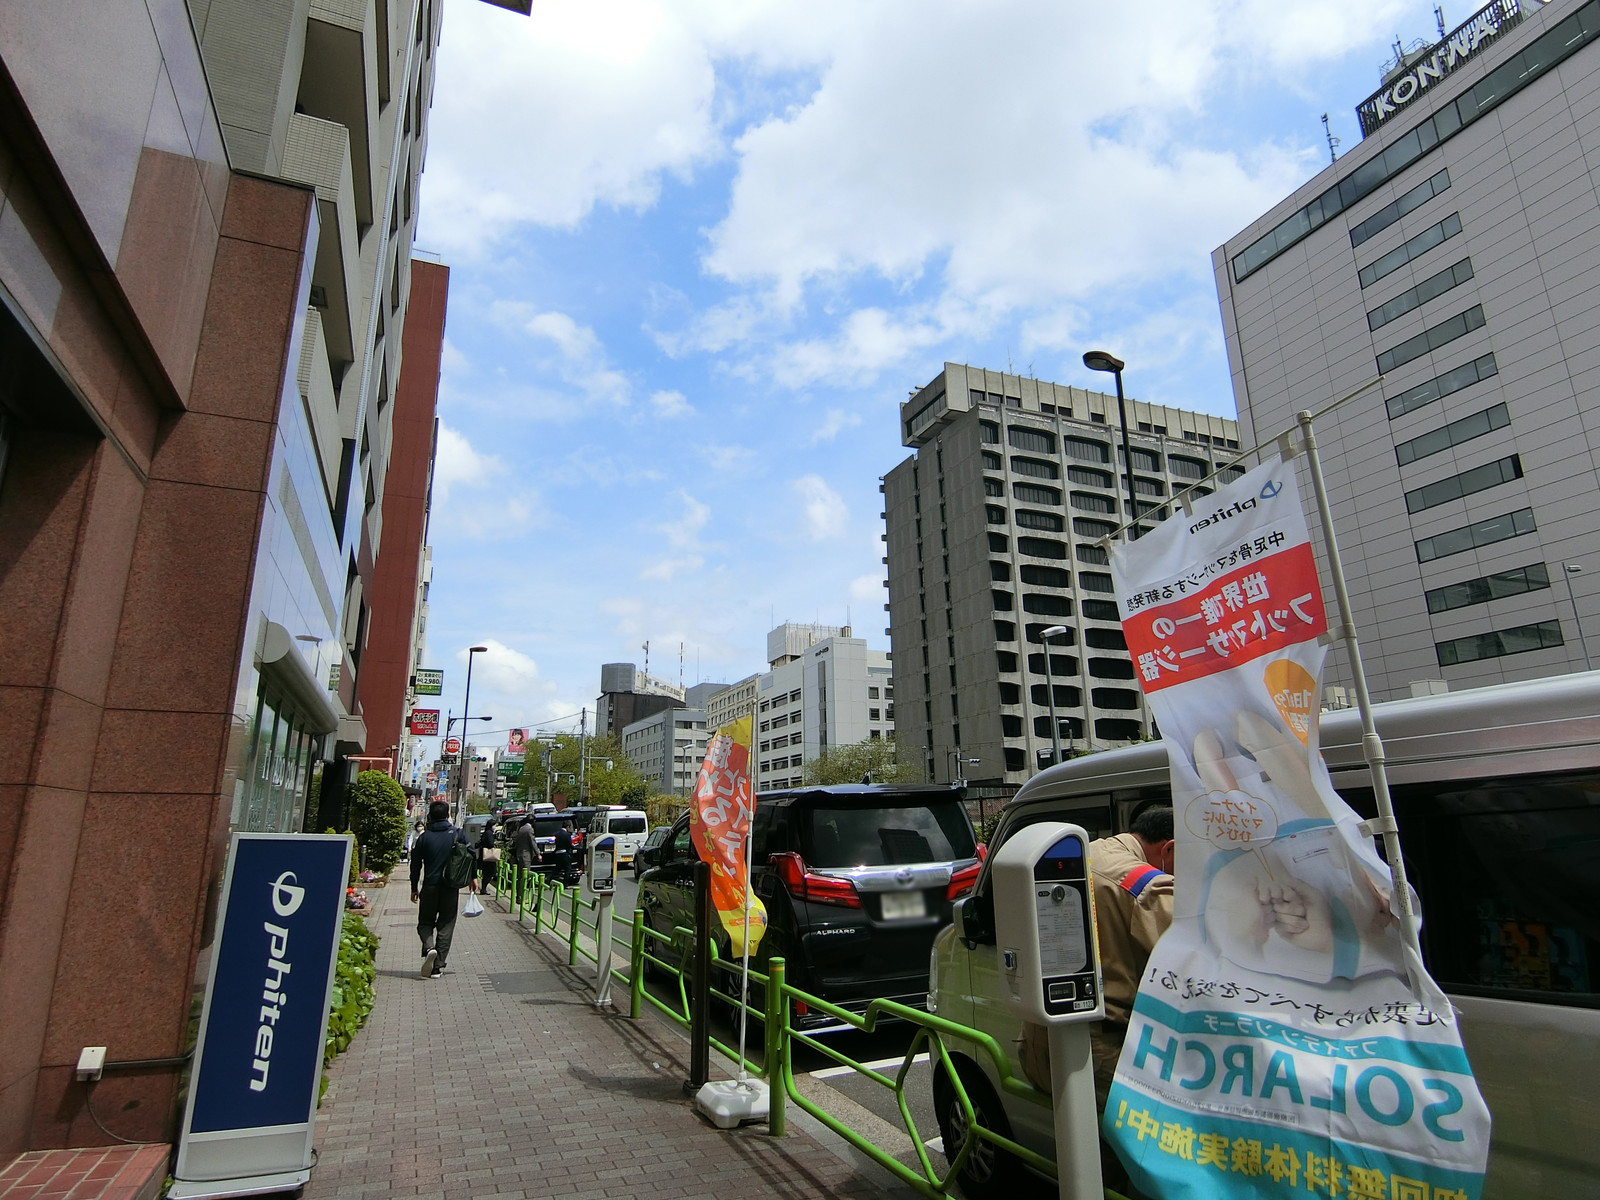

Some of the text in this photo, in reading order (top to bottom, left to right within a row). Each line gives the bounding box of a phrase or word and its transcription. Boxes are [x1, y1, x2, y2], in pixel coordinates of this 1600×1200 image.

[1374, 18, 1498, 120] KONWA
[816, 928, 856, 936] ALPHARD
[249, 921, 292, 1092] phiten
